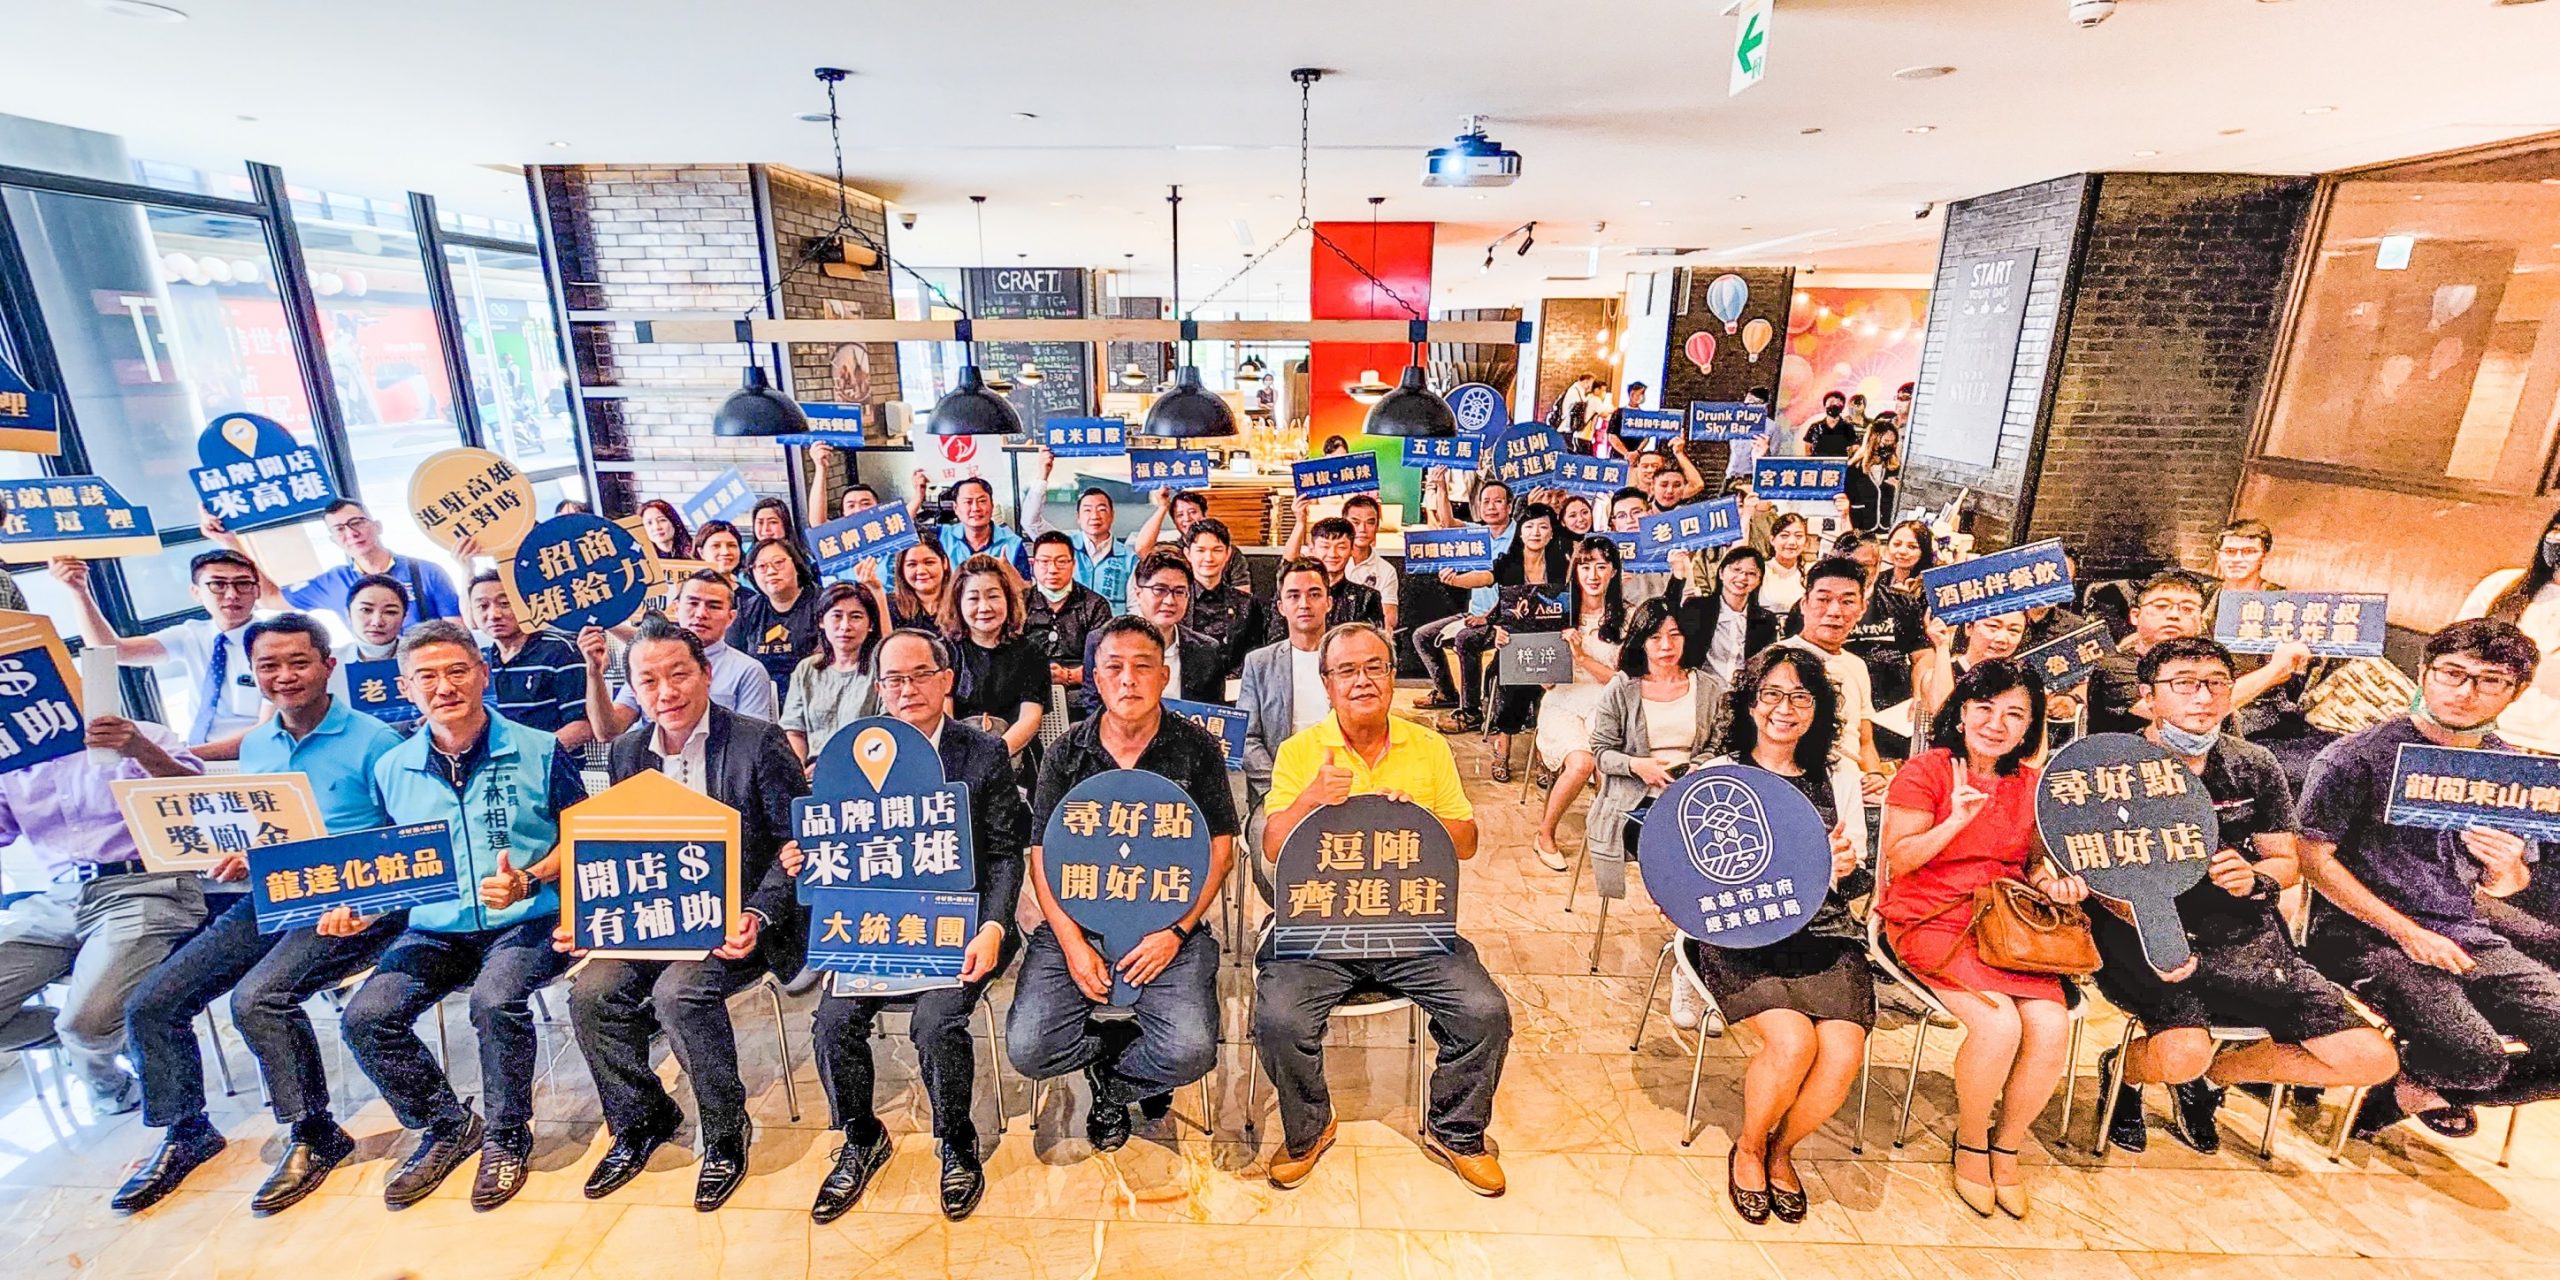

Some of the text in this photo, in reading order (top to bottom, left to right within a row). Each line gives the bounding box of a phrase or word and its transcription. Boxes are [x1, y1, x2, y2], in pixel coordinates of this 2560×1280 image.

[998, 270, 1058, 292] CRAFT
[1971, 260, 2014, 287] START
[1696, 408, 1763, 424] Drunk Play
[1705, 422, 1752, 435] Sky Bar
[1412, 438, 1472, 458] 五花馬
[198, 448, 317, 493] 品牌開店
[207, 470, 330, 522] 來高雄
[417, 457, 518, 531] 進駐高雄
[451, 494, 523, 540] 正對時
[1652, 508, 1729, 543] 老四川
[537, 527, 619, 582] 招商
[526, 557, 656, 625] 雄給力
[1935, 560, 2062, 608] 酒點伴餐飲
[1534, 602, 1563, 615] A&B
[152, 788, 282, 819] 百萬進駐
[2046, 758, 2188, 806] 尋好點
[482, 785, 512, 851] 林相達
[801, 790, 957, 837] 品牌開店
[1062, 800, 1195, 839] 尋好點
[165, 822, 290, 858] 獎勵金
[803, 829, 962, 887] 來高雄
[1316, 829, 1421, 872] 逗陣
[2064, 821, 2208, 872] 開好店
[265, 847, 445, 905] 龍達化粧品
[1060, 862, 1192, 902] 開好店
[1287, 876, 1447, 919] 齊進駐
[1698, 877, 1794, 914] 高雄市政府
[585, 894, 724, 948] 有補助
[821, 911, 967, 948] 大統集團
[1704, 898, 1802, 934] 經濟發展局
